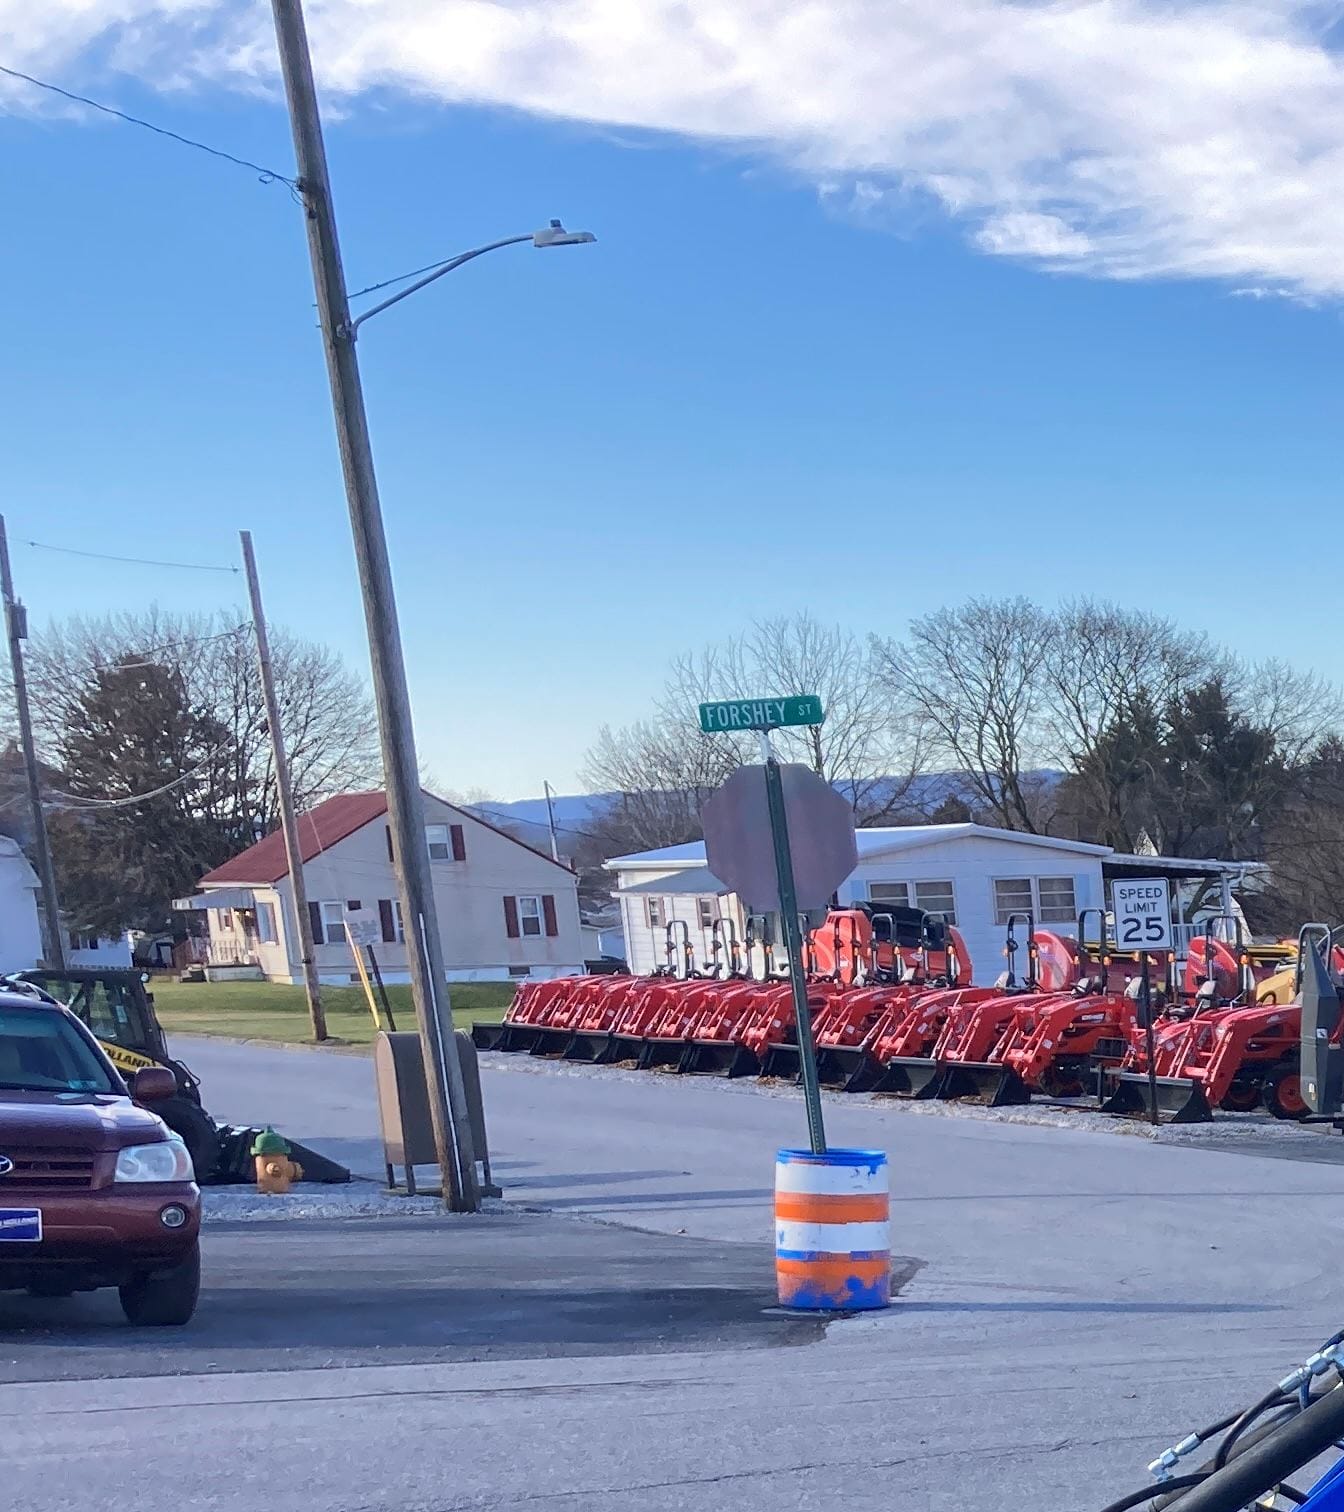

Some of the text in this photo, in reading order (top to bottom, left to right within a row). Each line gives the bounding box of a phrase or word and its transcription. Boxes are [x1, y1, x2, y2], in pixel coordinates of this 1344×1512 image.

[705, 701, 811, 728] FORSHEY ST
[1119, 887, 1163, 899] SPEED
[1125, 902, 1158, 914] LIMIT
[1122, 916, 1165, 943] 25
[103, 1047, 151, 1067] OLLAND
